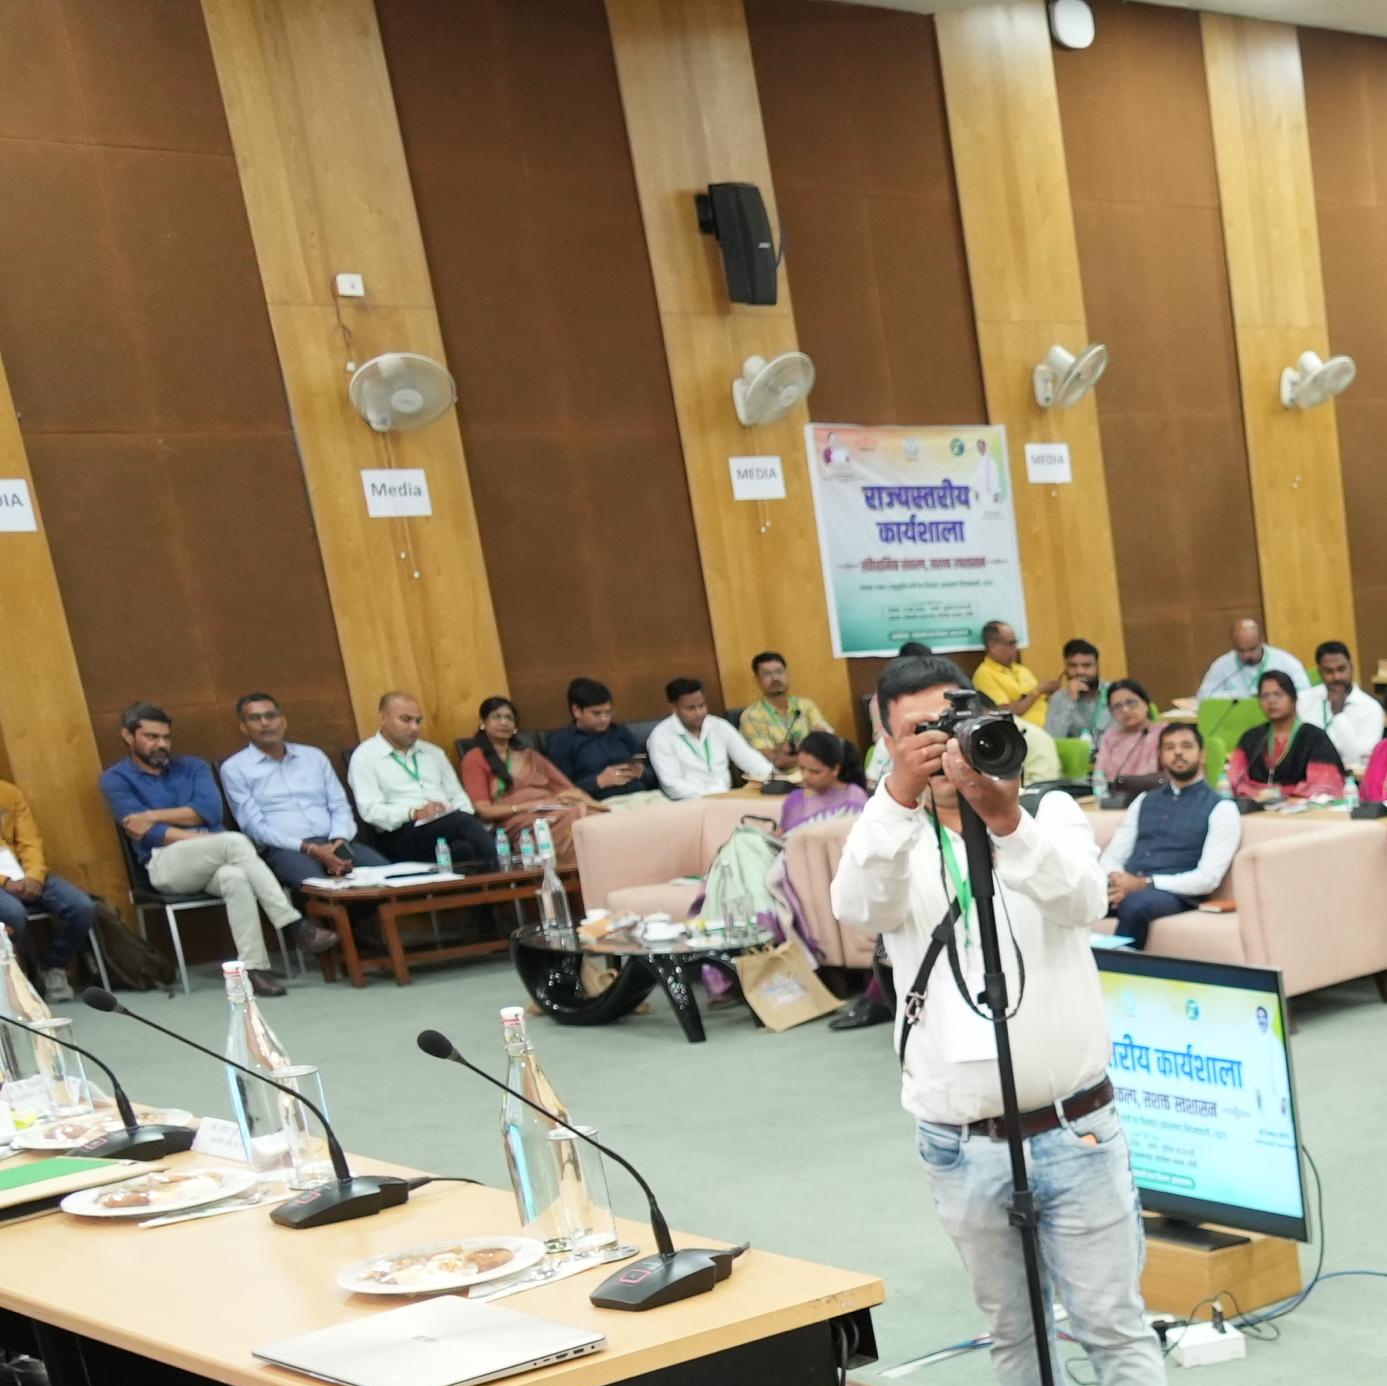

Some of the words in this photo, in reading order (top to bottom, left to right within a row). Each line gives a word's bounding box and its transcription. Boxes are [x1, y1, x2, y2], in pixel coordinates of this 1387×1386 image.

[736, 468, 778, 480] MEDIA
[370, 482, 422, 497] Media
[862, 479, 971, 511] राज्यस्तरीय
[876, 515, 965, 545] कार्यशाला
[1153, 1044, 1244, 1089] कार्यशाला
